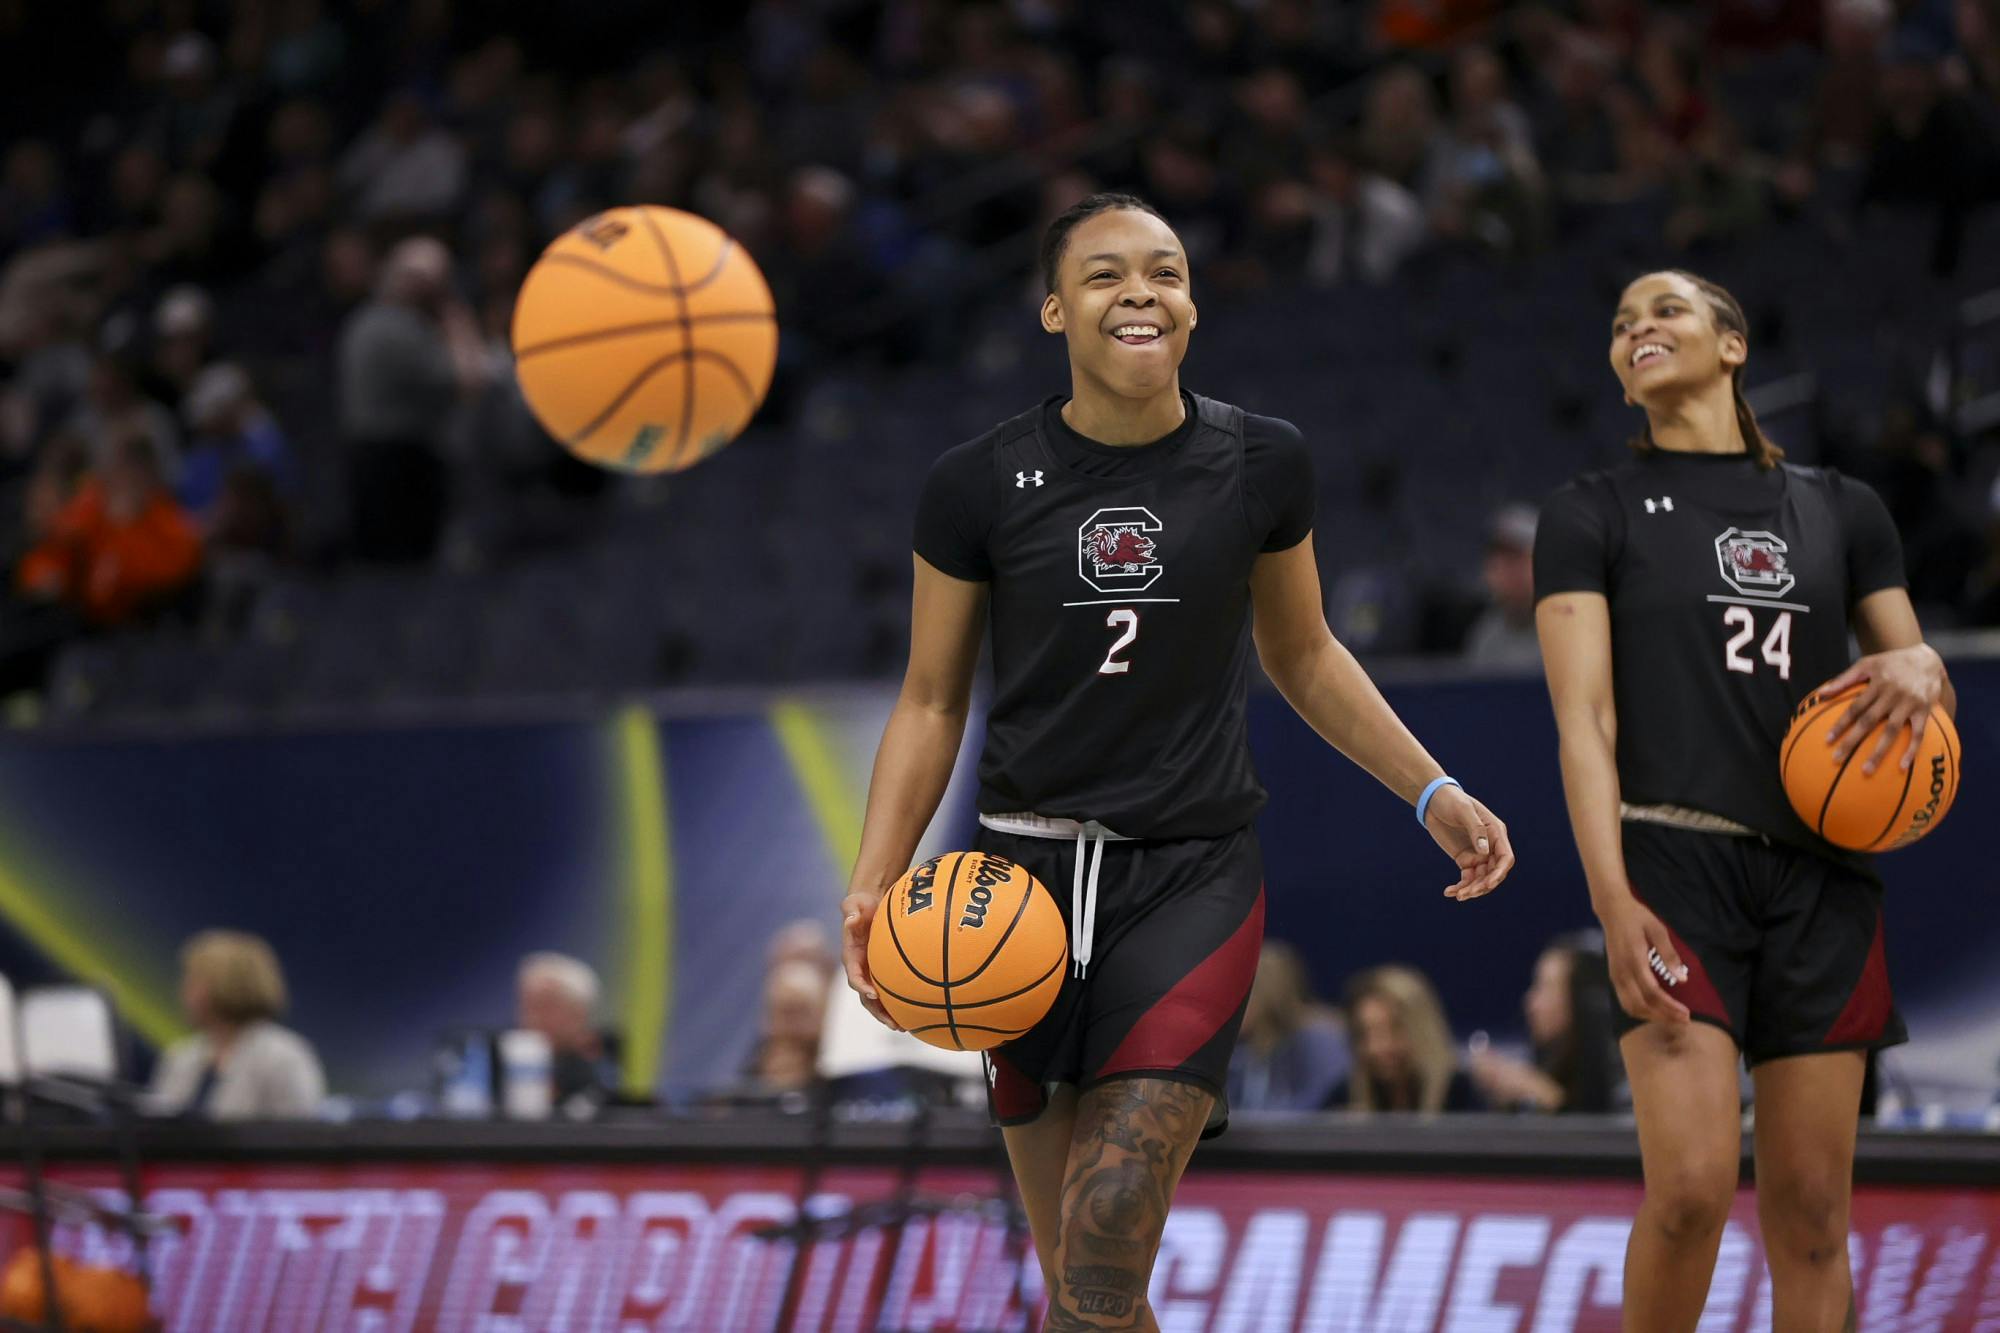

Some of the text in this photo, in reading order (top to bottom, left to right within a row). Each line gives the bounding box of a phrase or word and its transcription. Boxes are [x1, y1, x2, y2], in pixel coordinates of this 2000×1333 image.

[1097, 607, 1139, 675] 2
[1723, 604, 1792, 681] 24
[1081, 1292, 1129, 1314] HERO
